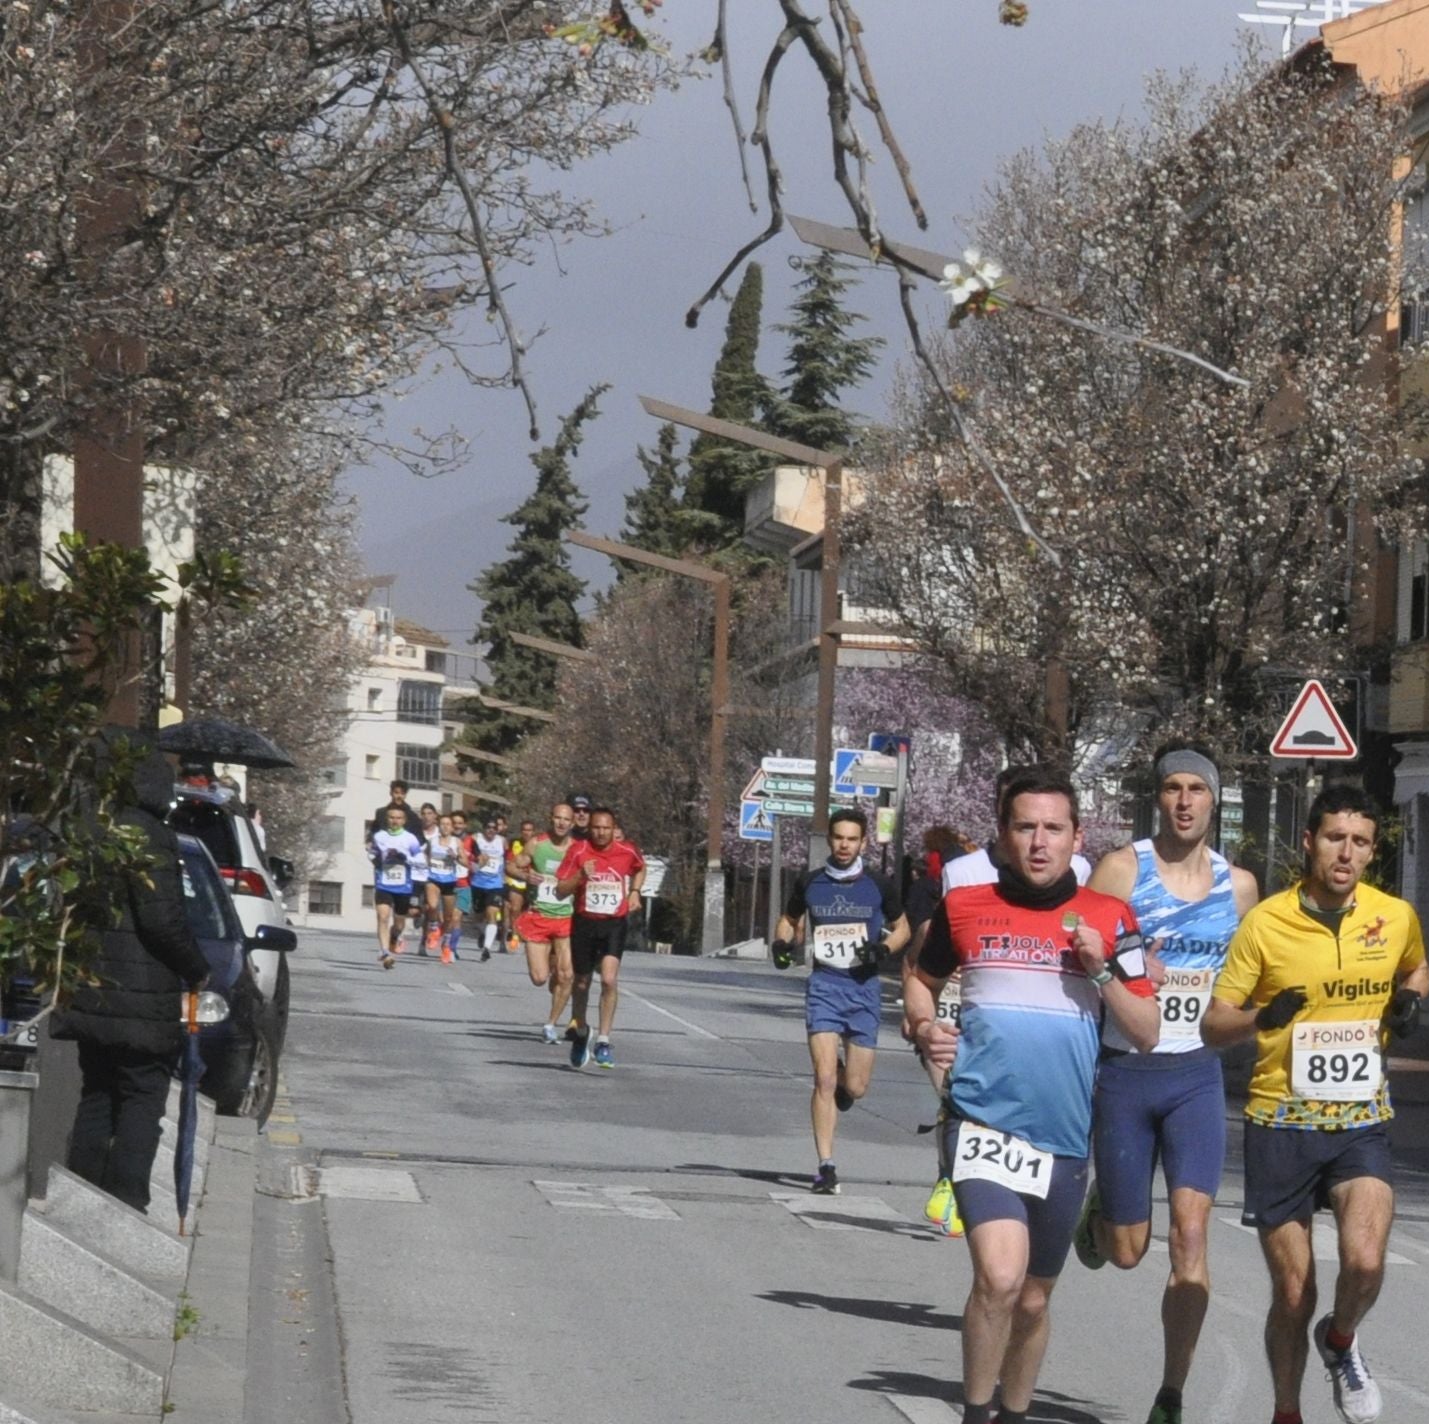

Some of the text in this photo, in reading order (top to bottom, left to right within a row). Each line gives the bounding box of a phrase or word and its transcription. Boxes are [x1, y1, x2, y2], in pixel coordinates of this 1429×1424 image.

[591, 893, 618, 906] 373
[1312, 1028, 1366, 1044] FONDO
[1307, 1052, 1370, 1083] 892
[962, 1137, 1042, 1179] 3201
